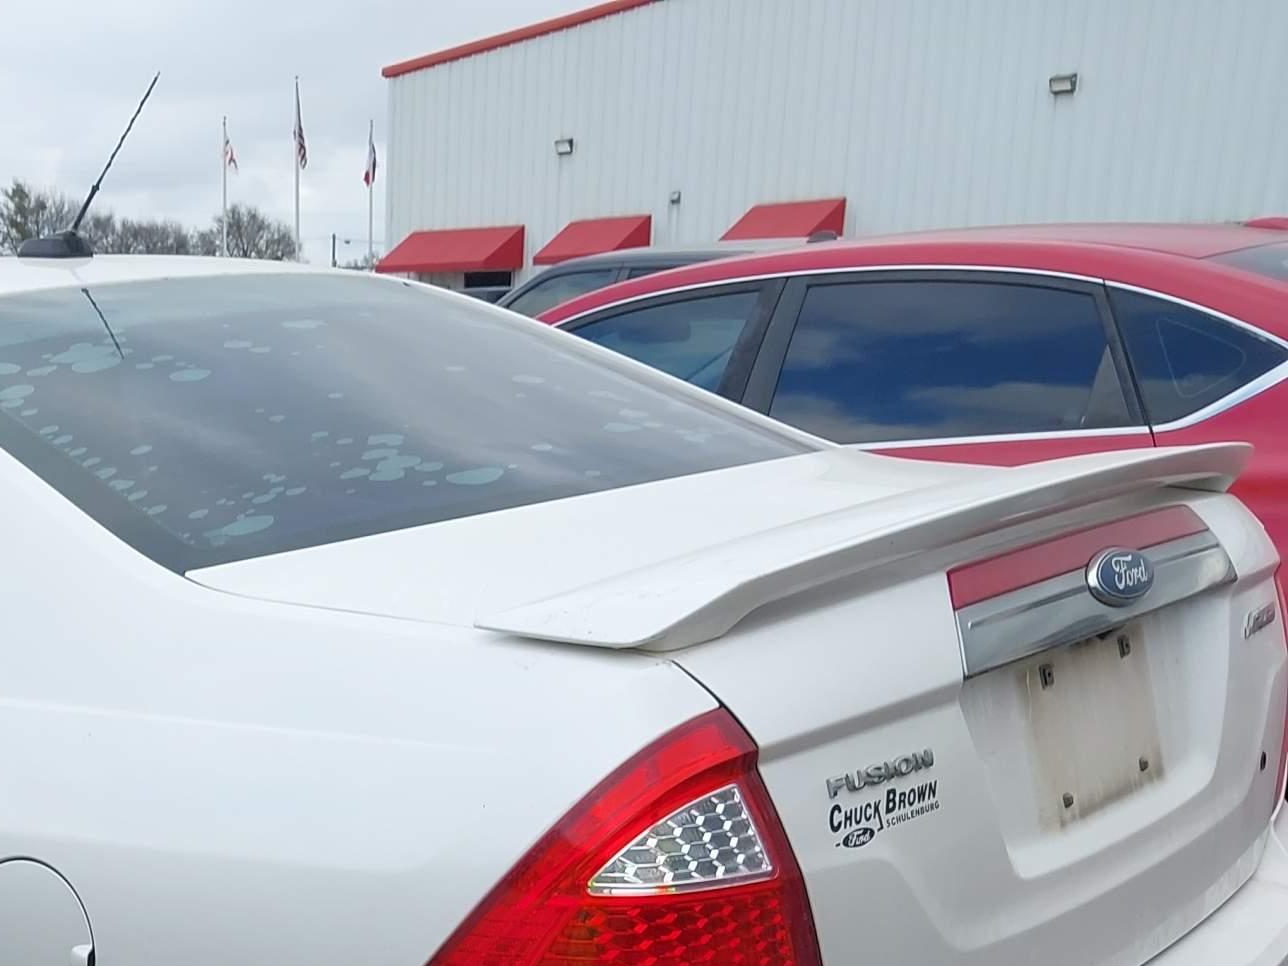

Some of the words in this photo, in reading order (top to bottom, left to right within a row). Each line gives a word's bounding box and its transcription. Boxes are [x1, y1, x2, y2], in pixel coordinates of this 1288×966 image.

[1111, 553, 1148, 590] Ford
[826, 747, 934, 800] FUSION
[829, 799, 884, 834] CHUCK
[885, 780, 938, 815] BROWN
[886, 800, 941, 829] SCHULENBURG
